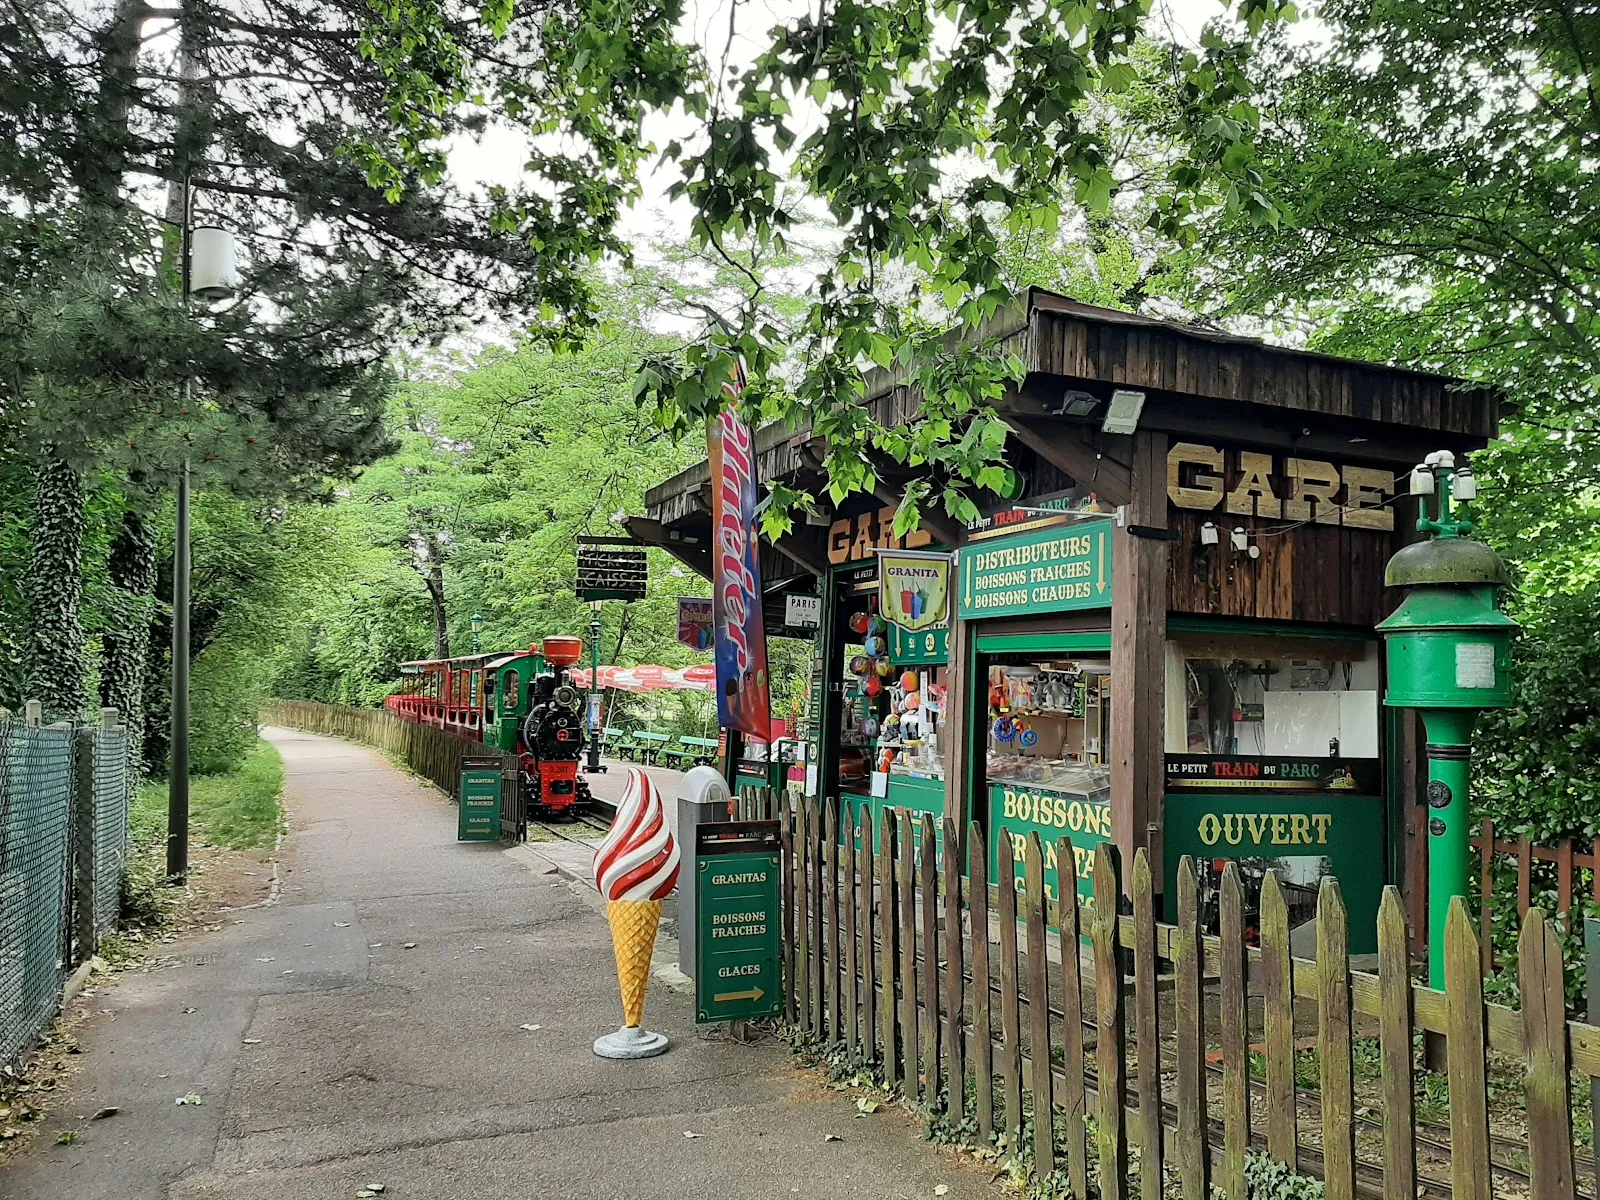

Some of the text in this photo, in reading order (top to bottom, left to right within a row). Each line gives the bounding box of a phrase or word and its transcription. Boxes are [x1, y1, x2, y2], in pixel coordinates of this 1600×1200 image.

[1167, 442, 1395, 531] GARE
[994, 510, 1025, 526] TRAIN
[585, 553, 639, 569] TICKETS
[976, 534, 1091, 572] DISTRIBUTEURS
[887, 567, 940, 578] GRANITA
[975, 560, 1091, 590] BOISSONS FRAICHES
[975, 581, 1091, 609] BOISSONS CHAUDES
[791, 599, 817, 609] PARIS
[1167, 762, 1320, 777] LE PETIT TRAIN DU PARC
[1003, 790, 1112, 838] BOISSONS
[1197, 813, 1332, 846] OUVERT
[712, 872, 767, 885] GRANITAS
[712, 911, 766, 925] BOISSONS
[712, 924, 767, 938] FRAICHES
[718, 964, 761, 978] GLACES
